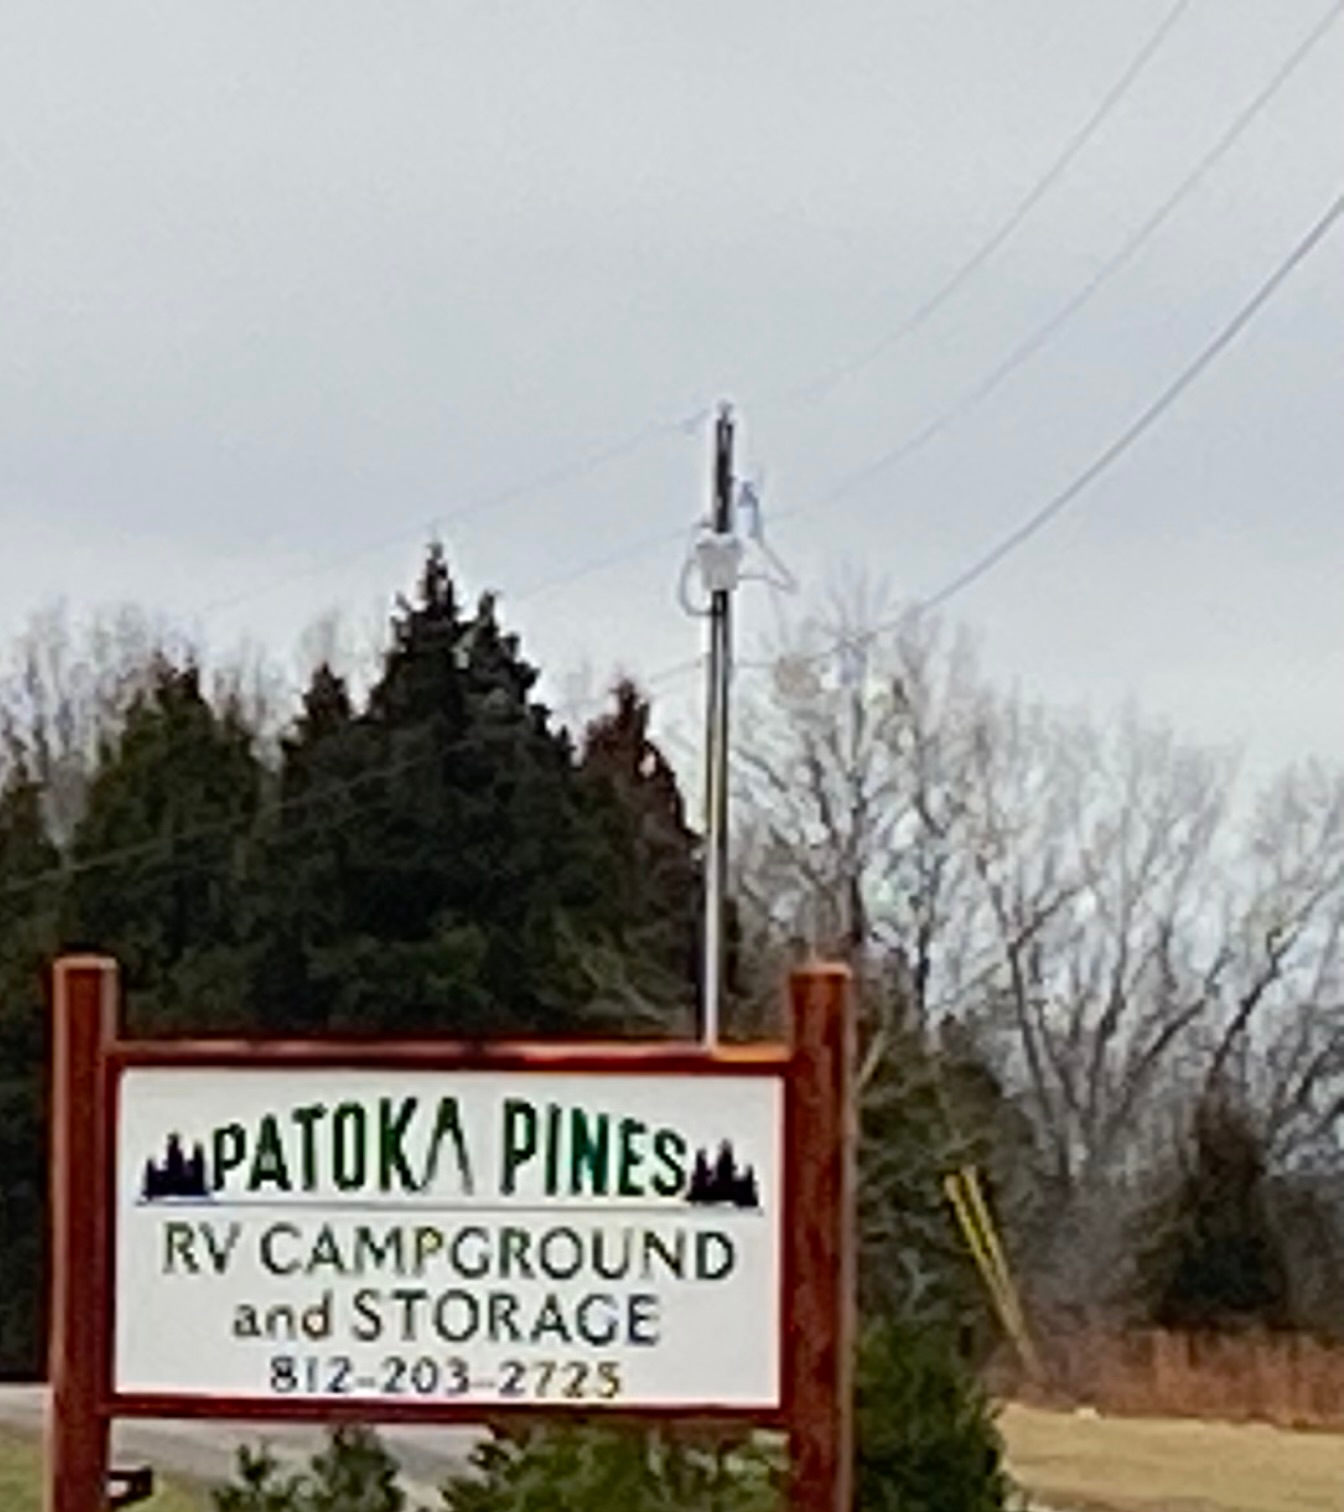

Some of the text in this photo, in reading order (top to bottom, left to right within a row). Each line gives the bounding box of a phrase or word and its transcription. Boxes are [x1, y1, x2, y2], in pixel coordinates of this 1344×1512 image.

[212, 1096, 687, 1198] PATOKA PINES
[162, 1222, 737, 1281] RV CAMPGROUND
[232, 1289, 659, 1348] and STORAGE
[269, 1355, 622, 1399] 812-203-2725
